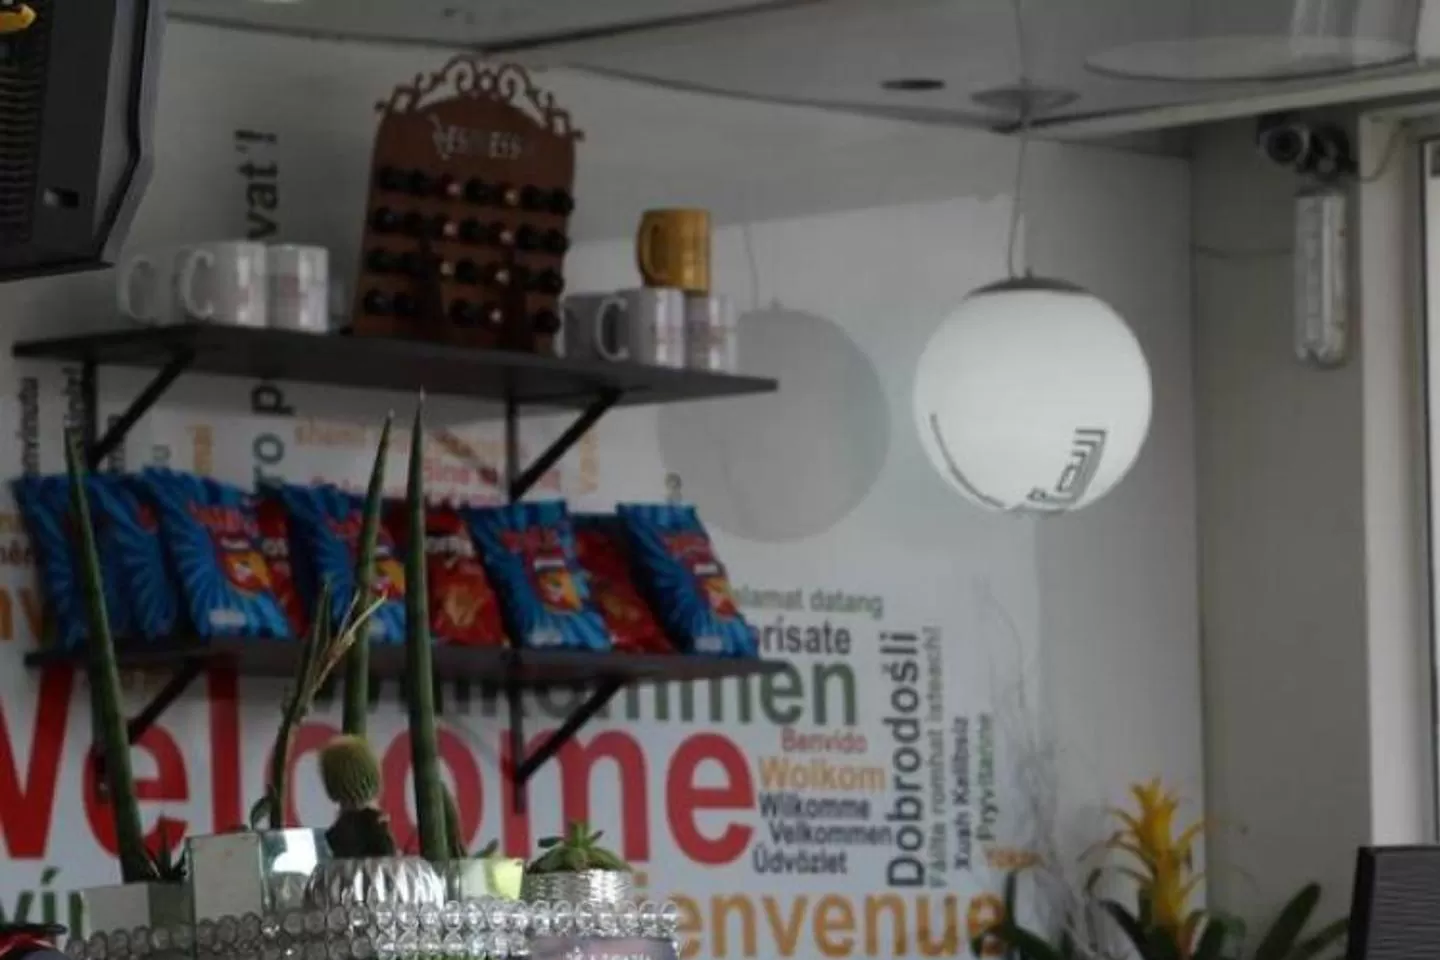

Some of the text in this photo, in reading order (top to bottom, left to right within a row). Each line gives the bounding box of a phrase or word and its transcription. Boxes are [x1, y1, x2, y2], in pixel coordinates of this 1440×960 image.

[757, 756, 885, 792] Wolkom
[880, 631, 926, 887] Dobrodošli
[769, 820, 892, 847] Velkommen
[635, 872, 1004, 960] envenue
